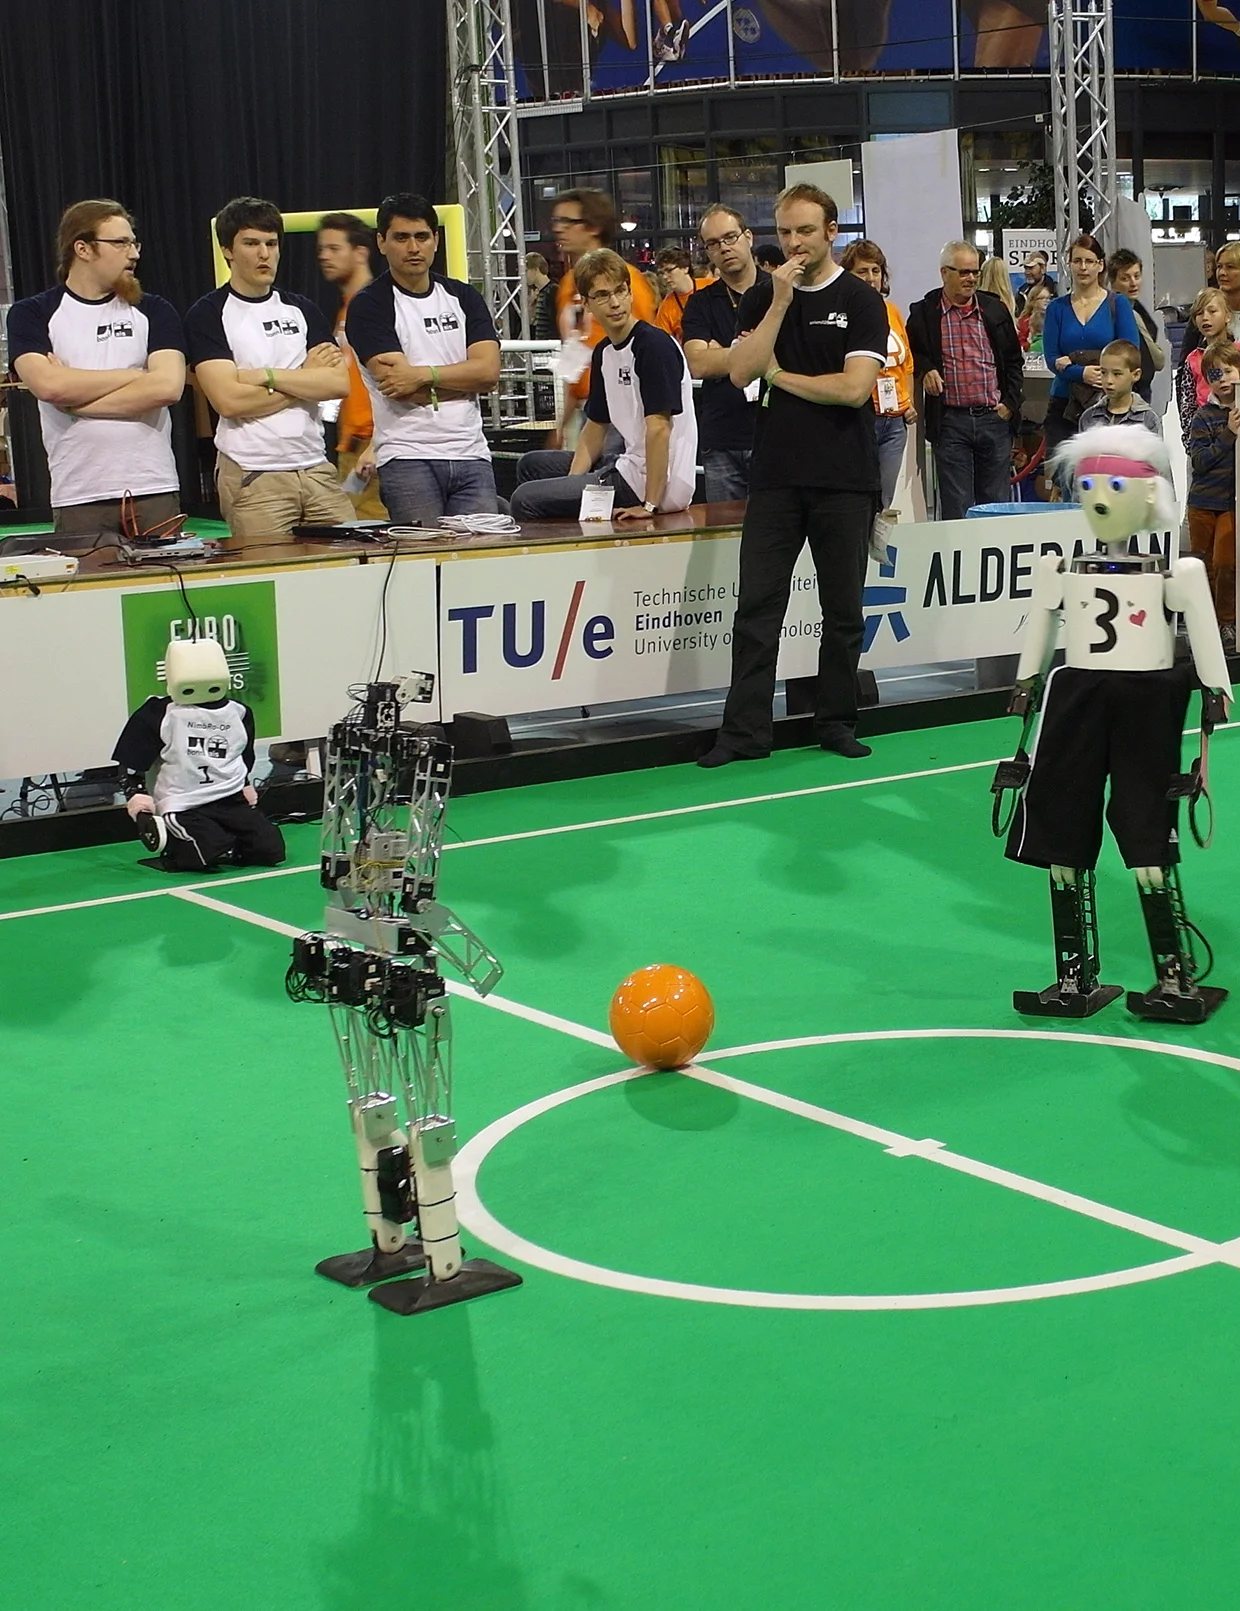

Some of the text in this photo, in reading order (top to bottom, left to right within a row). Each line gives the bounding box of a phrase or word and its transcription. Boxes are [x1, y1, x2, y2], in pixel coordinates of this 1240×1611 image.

[1009, 239, 1057, 248] EINDHO
[923, 532, 1171, 608] ALDEN
[634, 584, 726, 607] Technische
[447, 580, 615, 680] TU/e
[635, 610, 722, 631] Eindhoven
[1089, 588, 1119, 653] 3
[635, 631, 718, 655] University
[198, 766, 214, 784] 1
